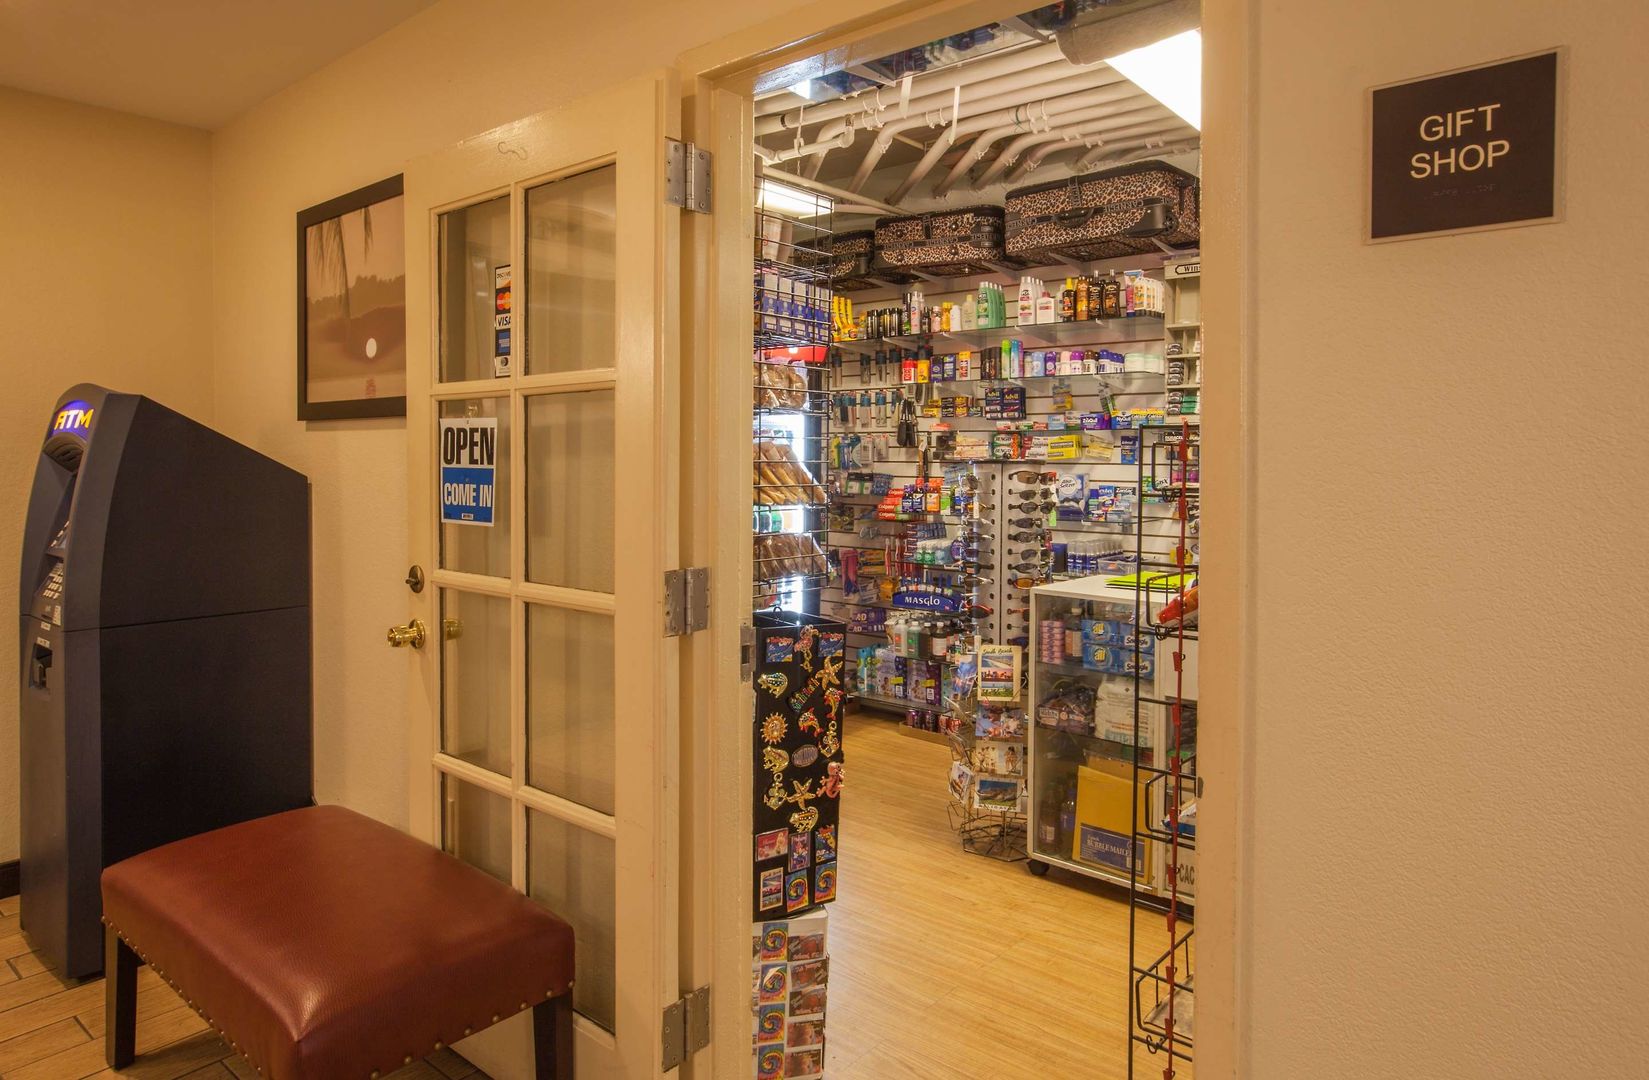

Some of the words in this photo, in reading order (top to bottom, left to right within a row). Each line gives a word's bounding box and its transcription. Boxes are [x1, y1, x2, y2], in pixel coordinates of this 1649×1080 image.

[1420, 103, 1501, 142] GIFT
[1410, 139, 1510, 179] SHOP
[54, 408, 95, 431] ATM
[443, 426, 495, 466] OPEN
[443, 482, 477, 507] COME
[479, 484, 492, 508] IN
